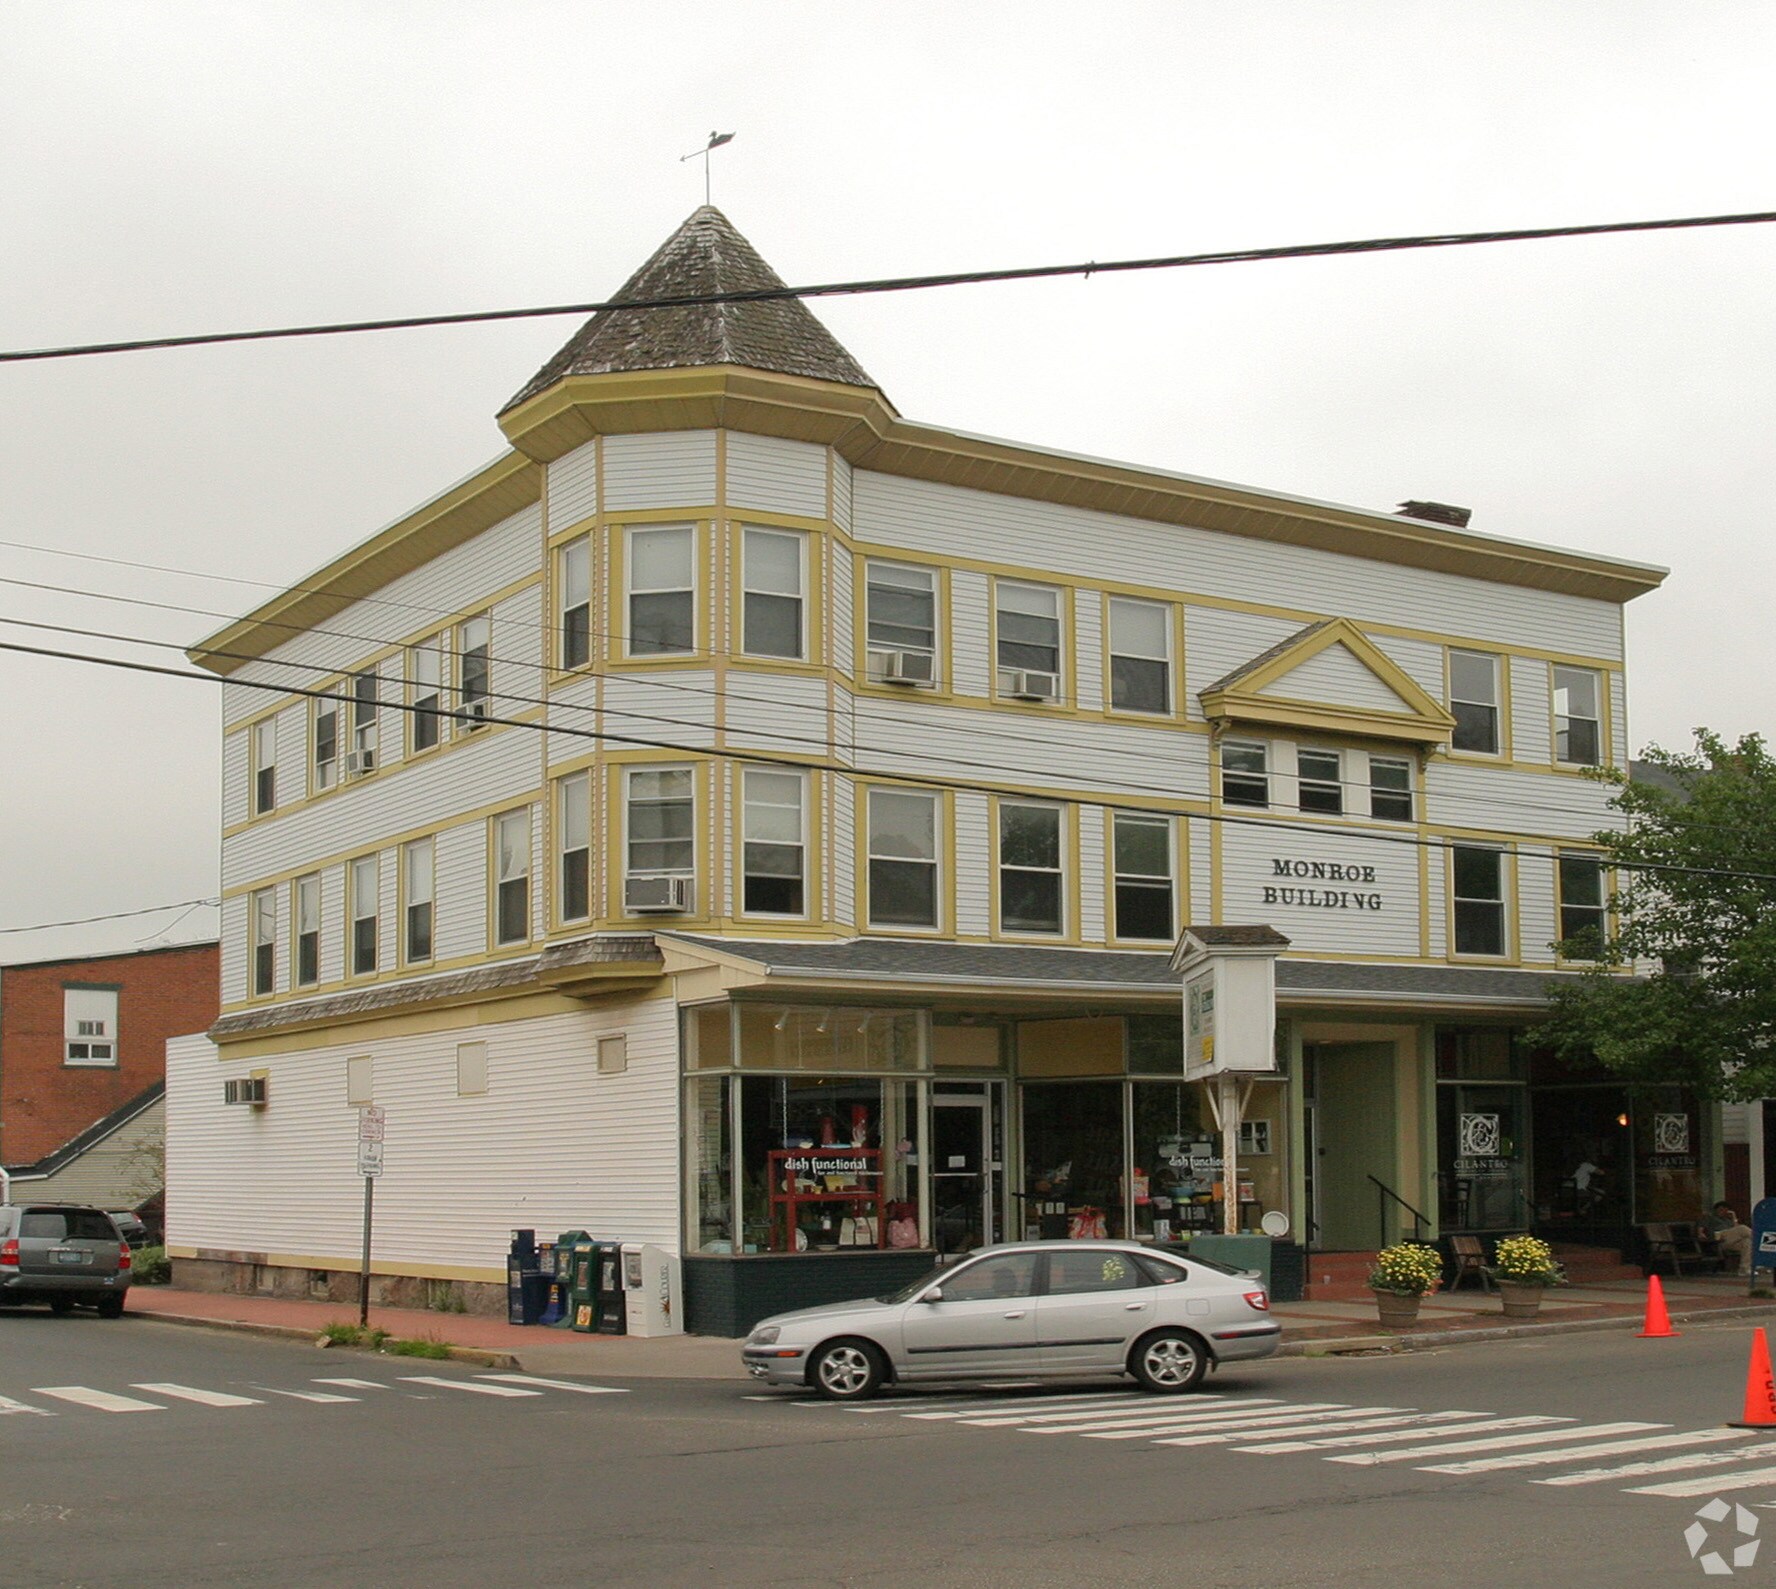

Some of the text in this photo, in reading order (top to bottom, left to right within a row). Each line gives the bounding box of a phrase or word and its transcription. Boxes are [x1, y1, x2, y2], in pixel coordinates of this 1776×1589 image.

[1272, 859, 1375, 882] MONROE
[1263, 887, 1382, 910] BUILDING
[784, 1157, 867, 1175] dish functional
